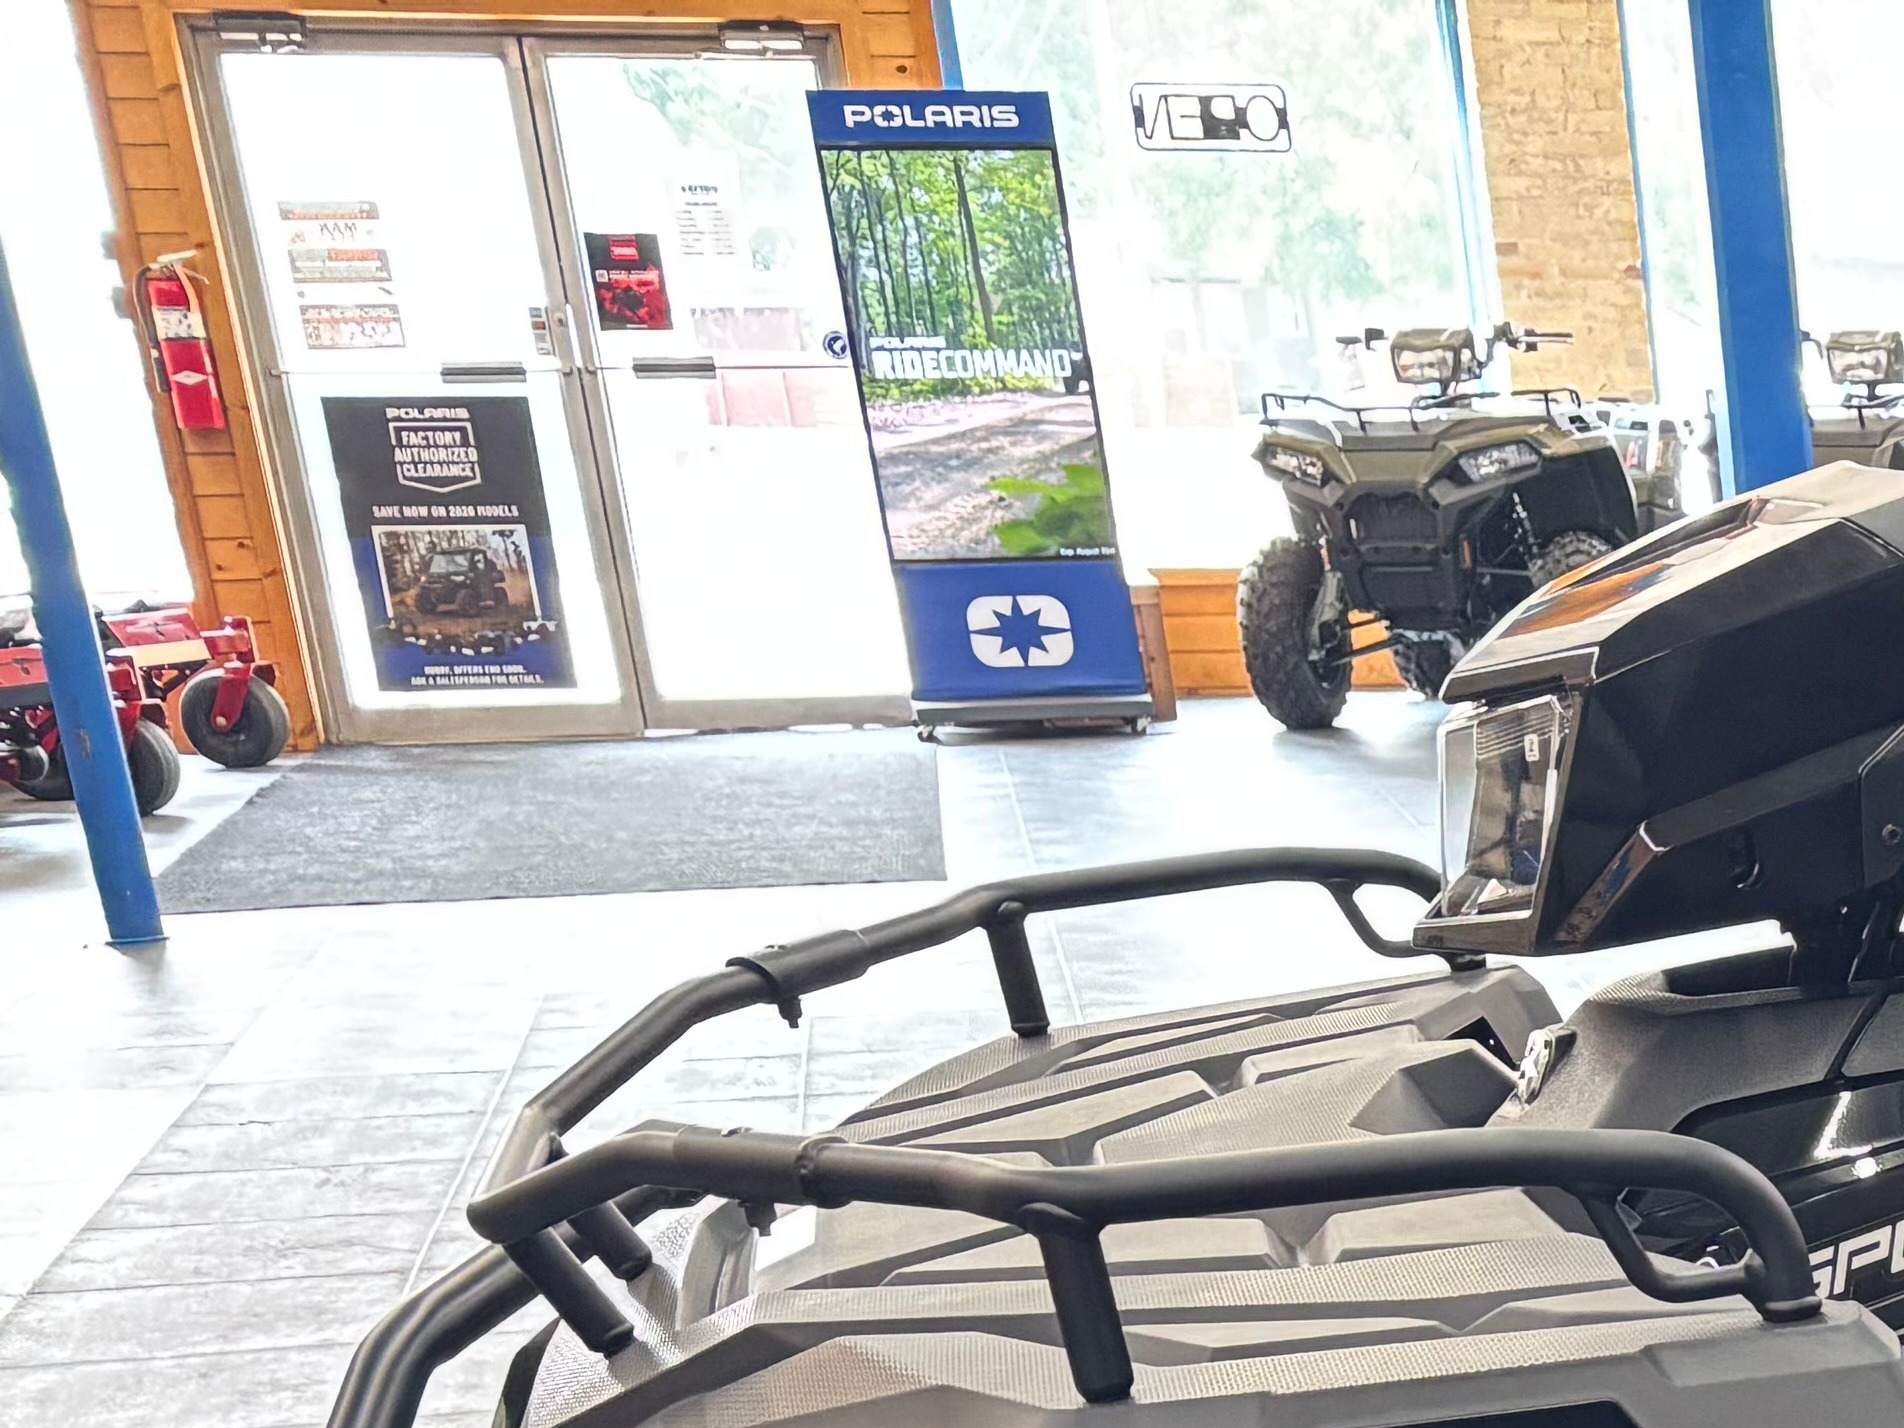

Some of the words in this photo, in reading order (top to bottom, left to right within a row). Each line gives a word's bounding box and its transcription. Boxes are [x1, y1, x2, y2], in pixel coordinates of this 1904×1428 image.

[843, 104, 1020, 128] POLARIS
[400, 430, 462, 447] FACTORY
[394, 447, 478, 463] AUTHORIZED
[402, 464, 474, 478] CLEARANCE
[372, 505, 400, 519] SAVE
[403, 505, 428, 518] NOW
[431, 505, 447, 518] ON
[477, 504, 519, 518] MODELS
